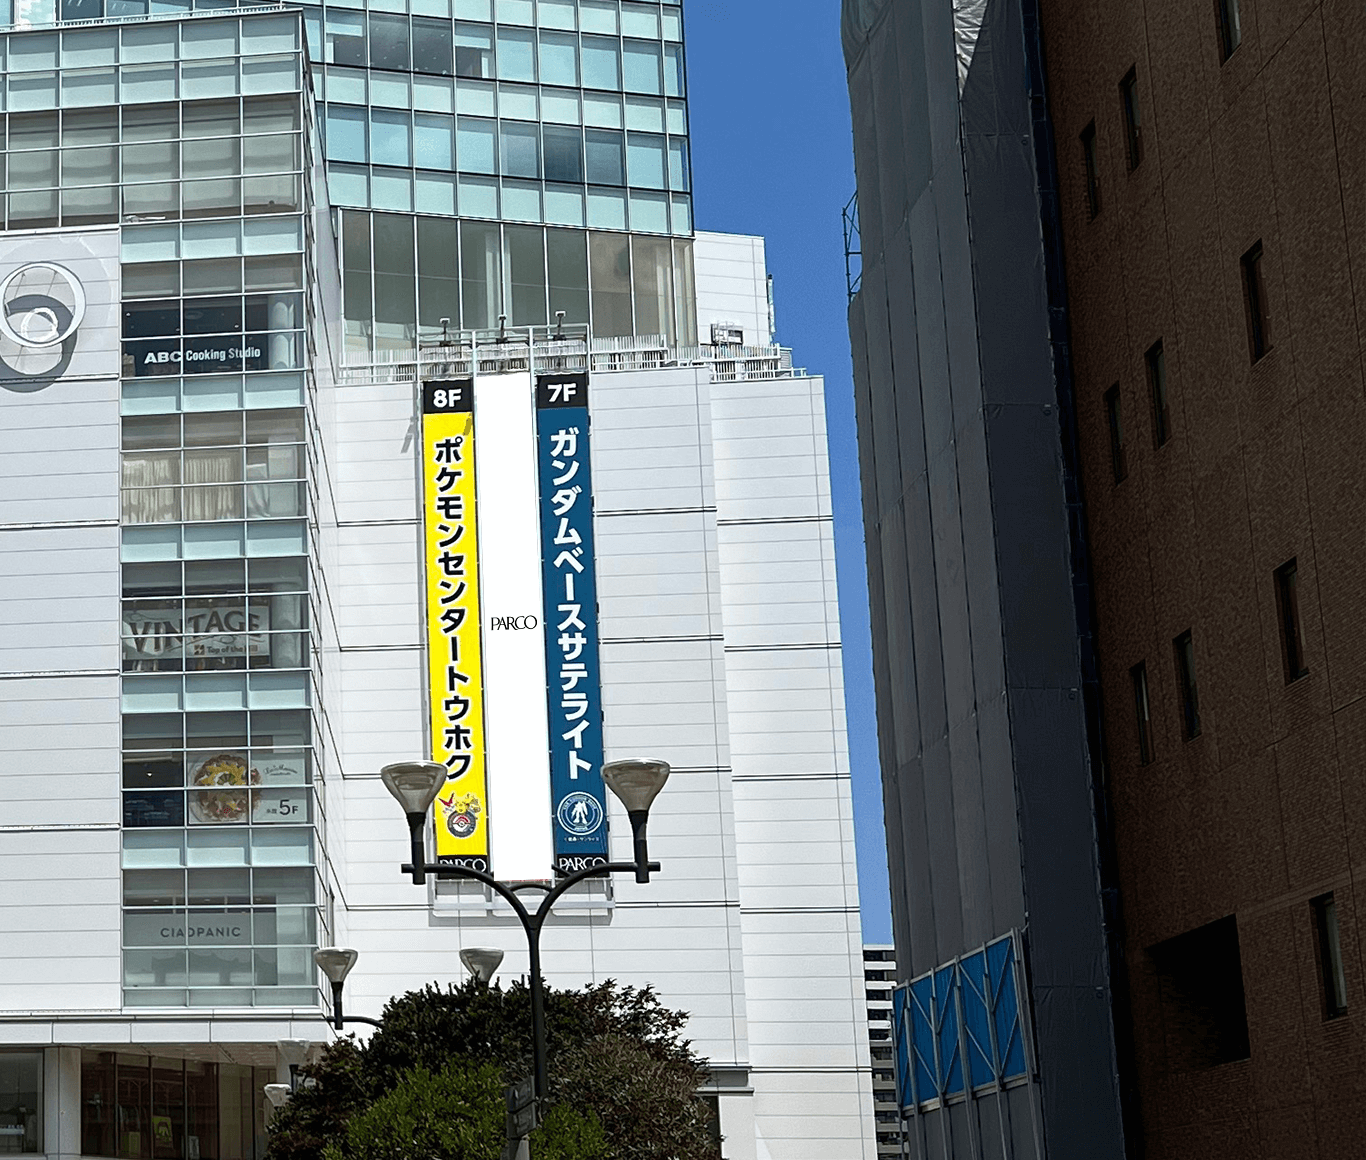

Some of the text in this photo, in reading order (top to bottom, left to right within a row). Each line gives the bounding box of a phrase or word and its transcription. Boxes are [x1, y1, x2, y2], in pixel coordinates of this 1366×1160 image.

[144, 347, 261, 364] ABC Cooking Studio
[433, 389, 462, 408] 8F
[547, 383, 577, 402] 7F
[435, 436, 472, 780] ポケモンセンタートウホク
[550, 427, 592, 780] ガンダムベースサテライト
[129, 610, 261, 653] VINTAGE
[491, 615, 538, 630] PARCO
[160, 927, 241, 938] CIAOPANIC
